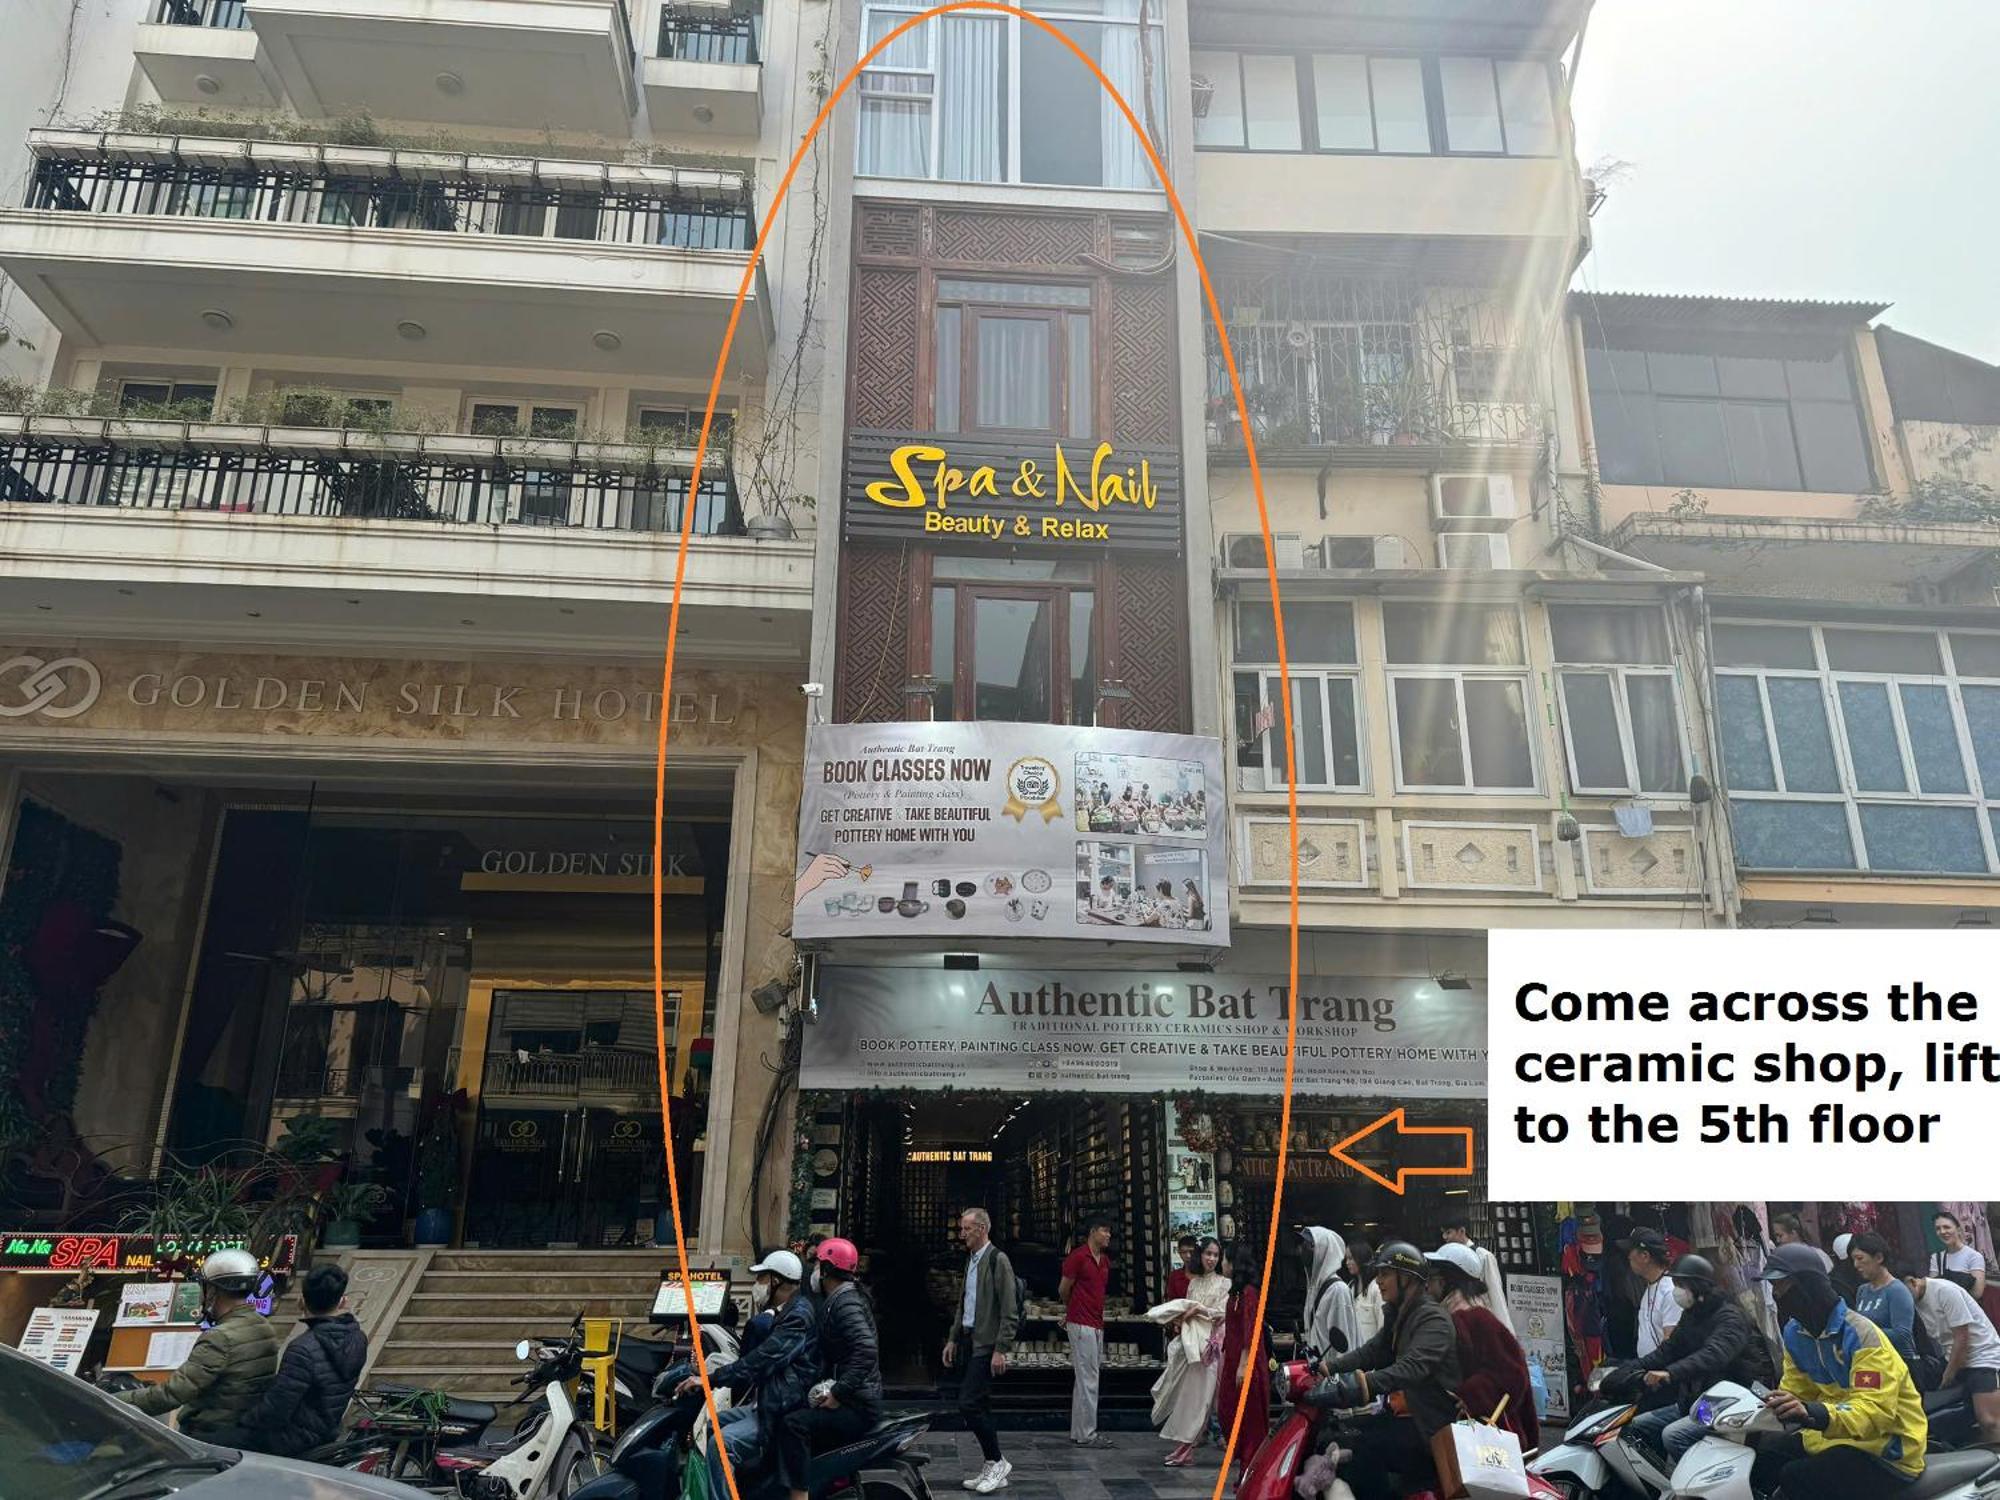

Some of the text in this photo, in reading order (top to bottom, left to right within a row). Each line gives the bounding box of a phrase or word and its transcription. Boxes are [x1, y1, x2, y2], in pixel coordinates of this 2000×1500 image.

[865, 441, 1158, 512] Spa & Nail
[924, 511, 1109, 540] Beauty & Relax
[127, 672, 738, 726] GOLDEN SILK HOTEL
[823, 759, 991, 783] BOOK CLASSES NOW
[821, 809, 839, 822] GET
[843, 808, 892, 822] CREATIVE
[905, 808, 930, 821] TAKE
[934, 808, 991, 821] BEAUTIFUL
[835, 828, 975, 843] POTTERY HOME WITH YOU
[480, 848, 609, 876] GOLDEN
[975, 981, 1396, 1033] Authentic Bat Trang
[1012, 1020, 1099, 1031] TRADITIONAL
[1104, 1022, 1162, 1033] POTTERY
[1165, 1024, 1232, 1035] CERAMICS
[1235, 1024, 1268, 1035] SHOP
[1285, 1026, 1358, 1037] ORKSHOP
[860, 1039, 896, 1051] BOOK
[899, 1040, 957, 1053] POTTERY,
[960, 1041, 1018, 1053] PAINTING
[1022, 1042, 1060, 1053] CLASS
[1063, 1042, 1096, 1053] NOW.
[1100, 1042, 1125, 1054] GET
[1130, 1042, 1196, 1056] CREATIVE
[1200, 1043, 1210, 1056] &
[1213, 1044, 1247, 1056] TAKE
[1331, 1046, 1393, 1059] POTTERY
[1397, 1047, 1438, 1060] HOME
[1441, 1048, 1477, 1061] WITH
[912, 1151, 993, 1162] AUTHENTIC BAT TRANG
[50, 1238, 119, 1267] SPA
[125, 1255, 155, 1267] NAIL
[690, 1272, 723, 1281] HOTEL
